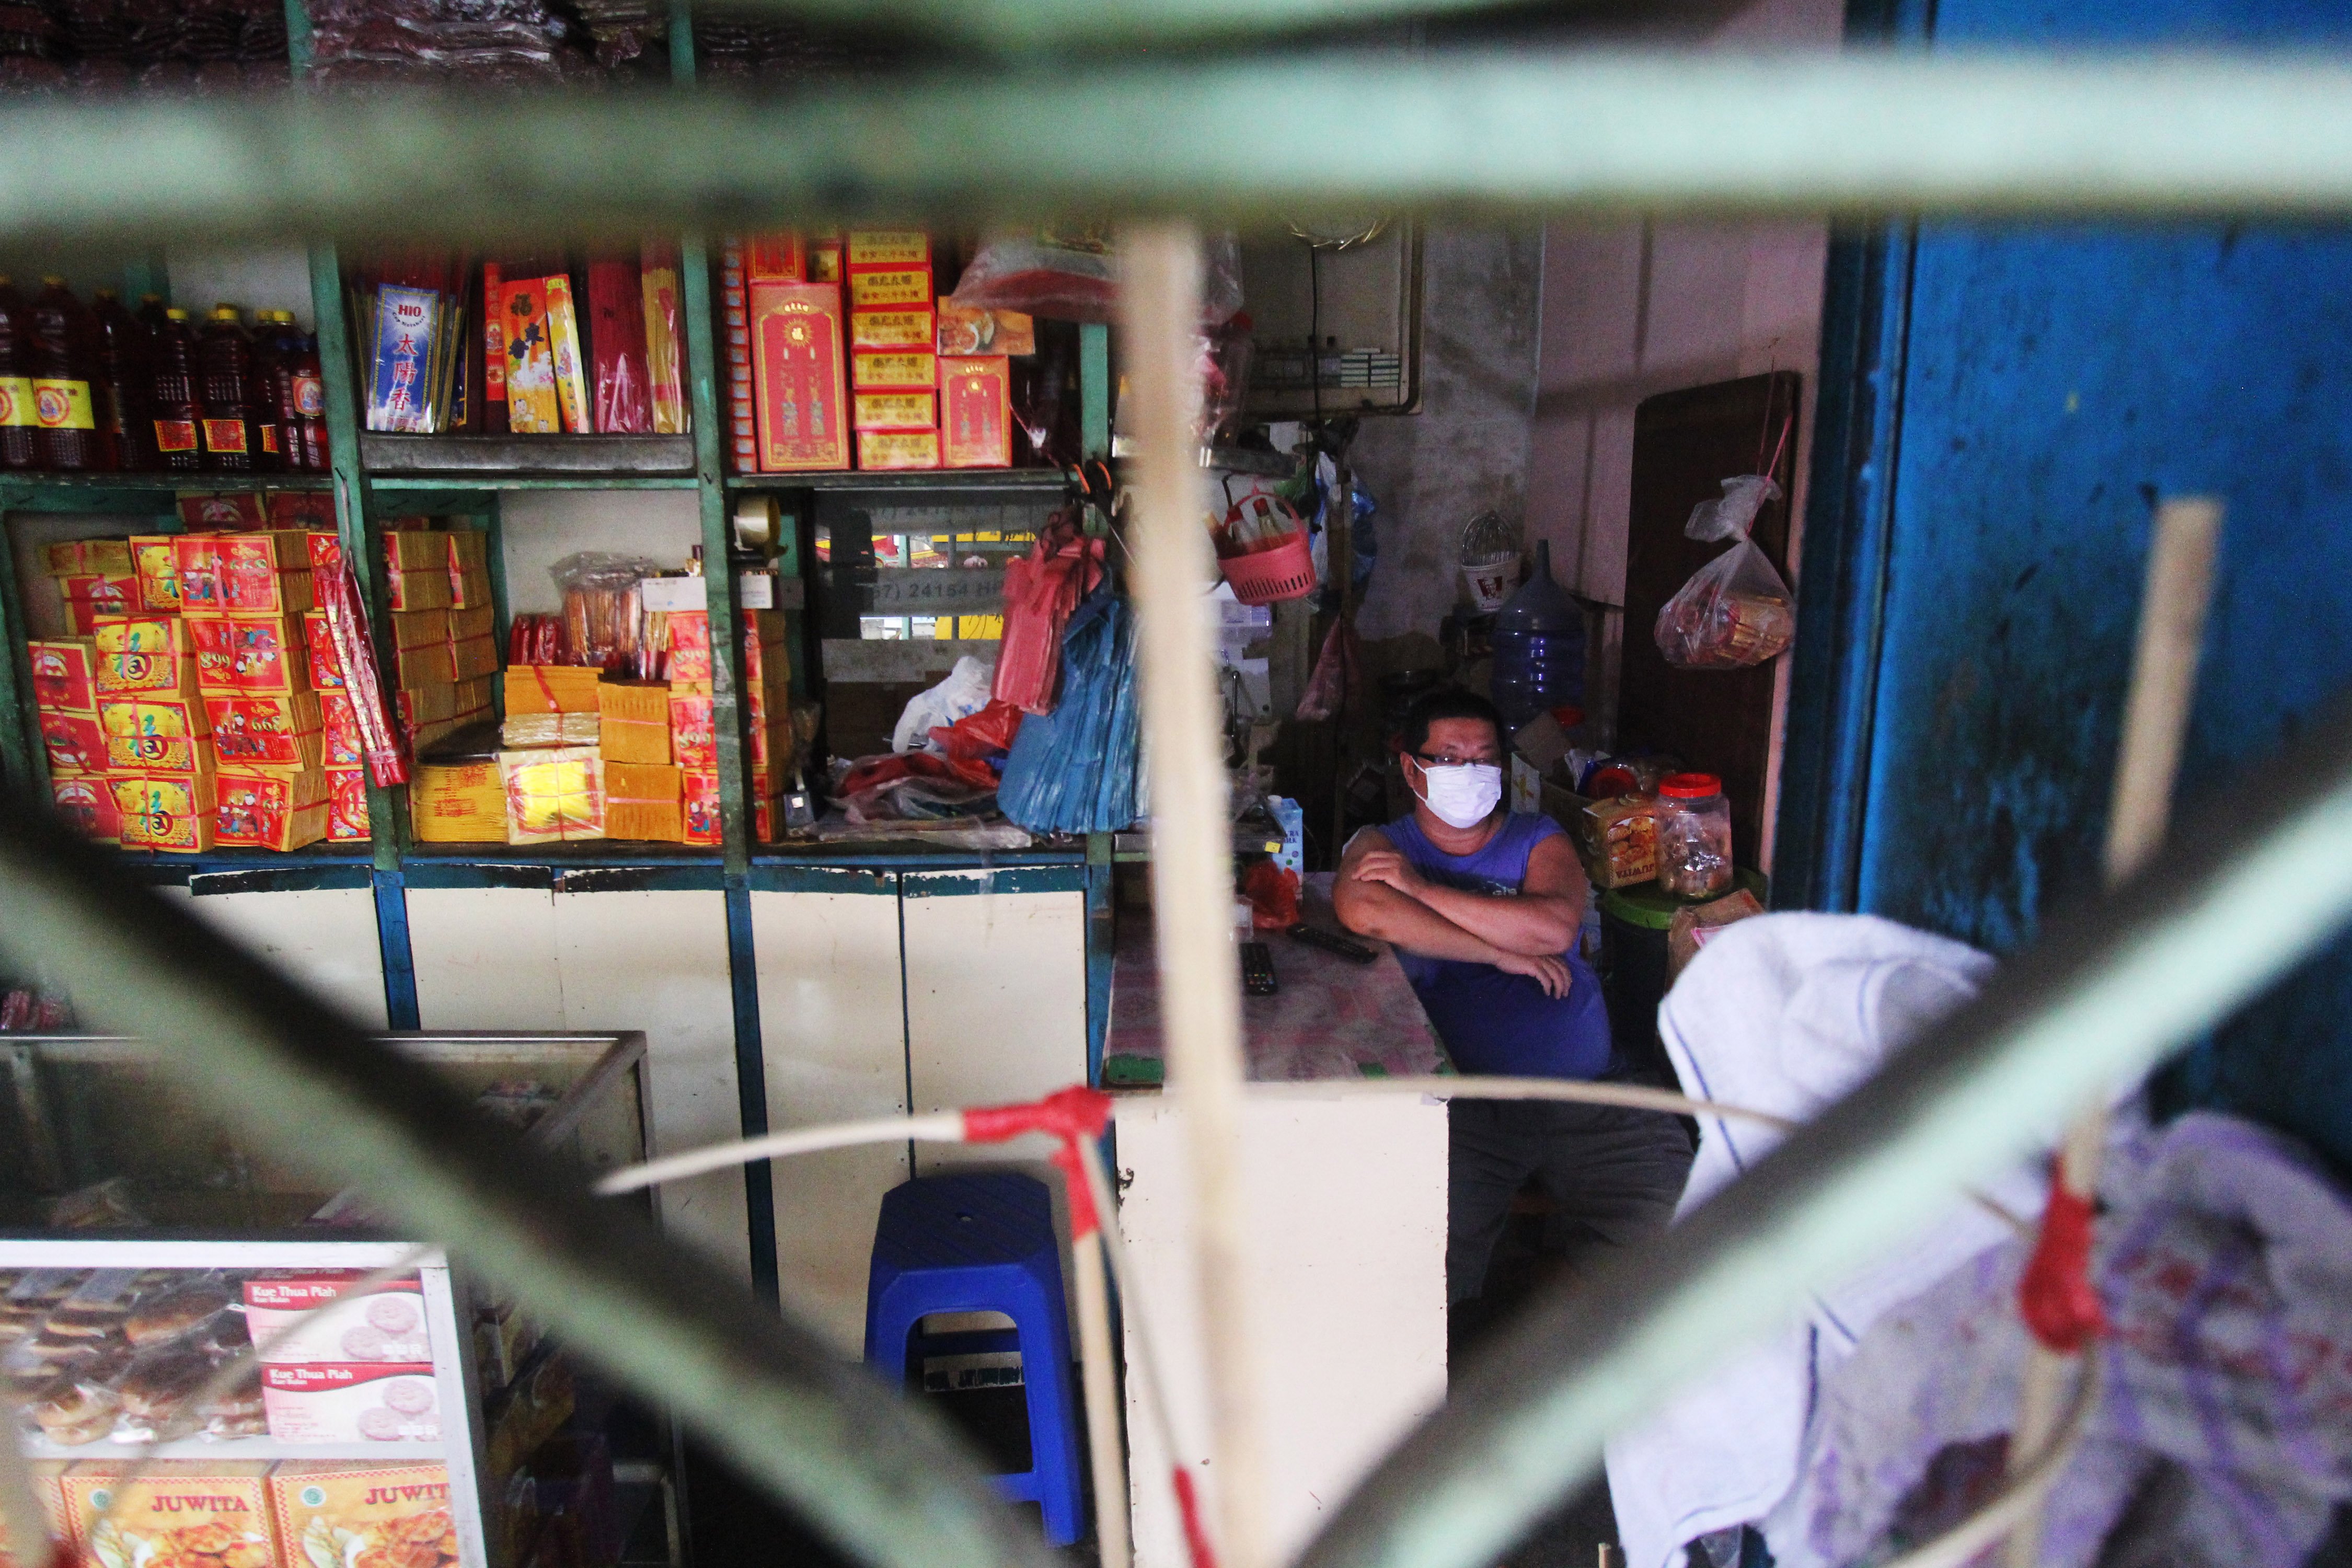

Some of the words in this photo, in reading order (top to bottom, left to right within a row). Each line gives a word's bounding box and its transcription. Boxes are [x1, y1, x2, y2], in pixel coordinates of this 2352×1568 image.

[390, 333, 418, 410] 太陽香
[252, 1286, 276, 1297] Kue
[278, 1286, 308, 1297] Thua
[269, 1368, 293, 1379] Kue
[295, 1368, 325, 1380] Thua
[365, 1482, 451, 1505] JUWIT
[152, 1495, 250, 1512] JUWITA
